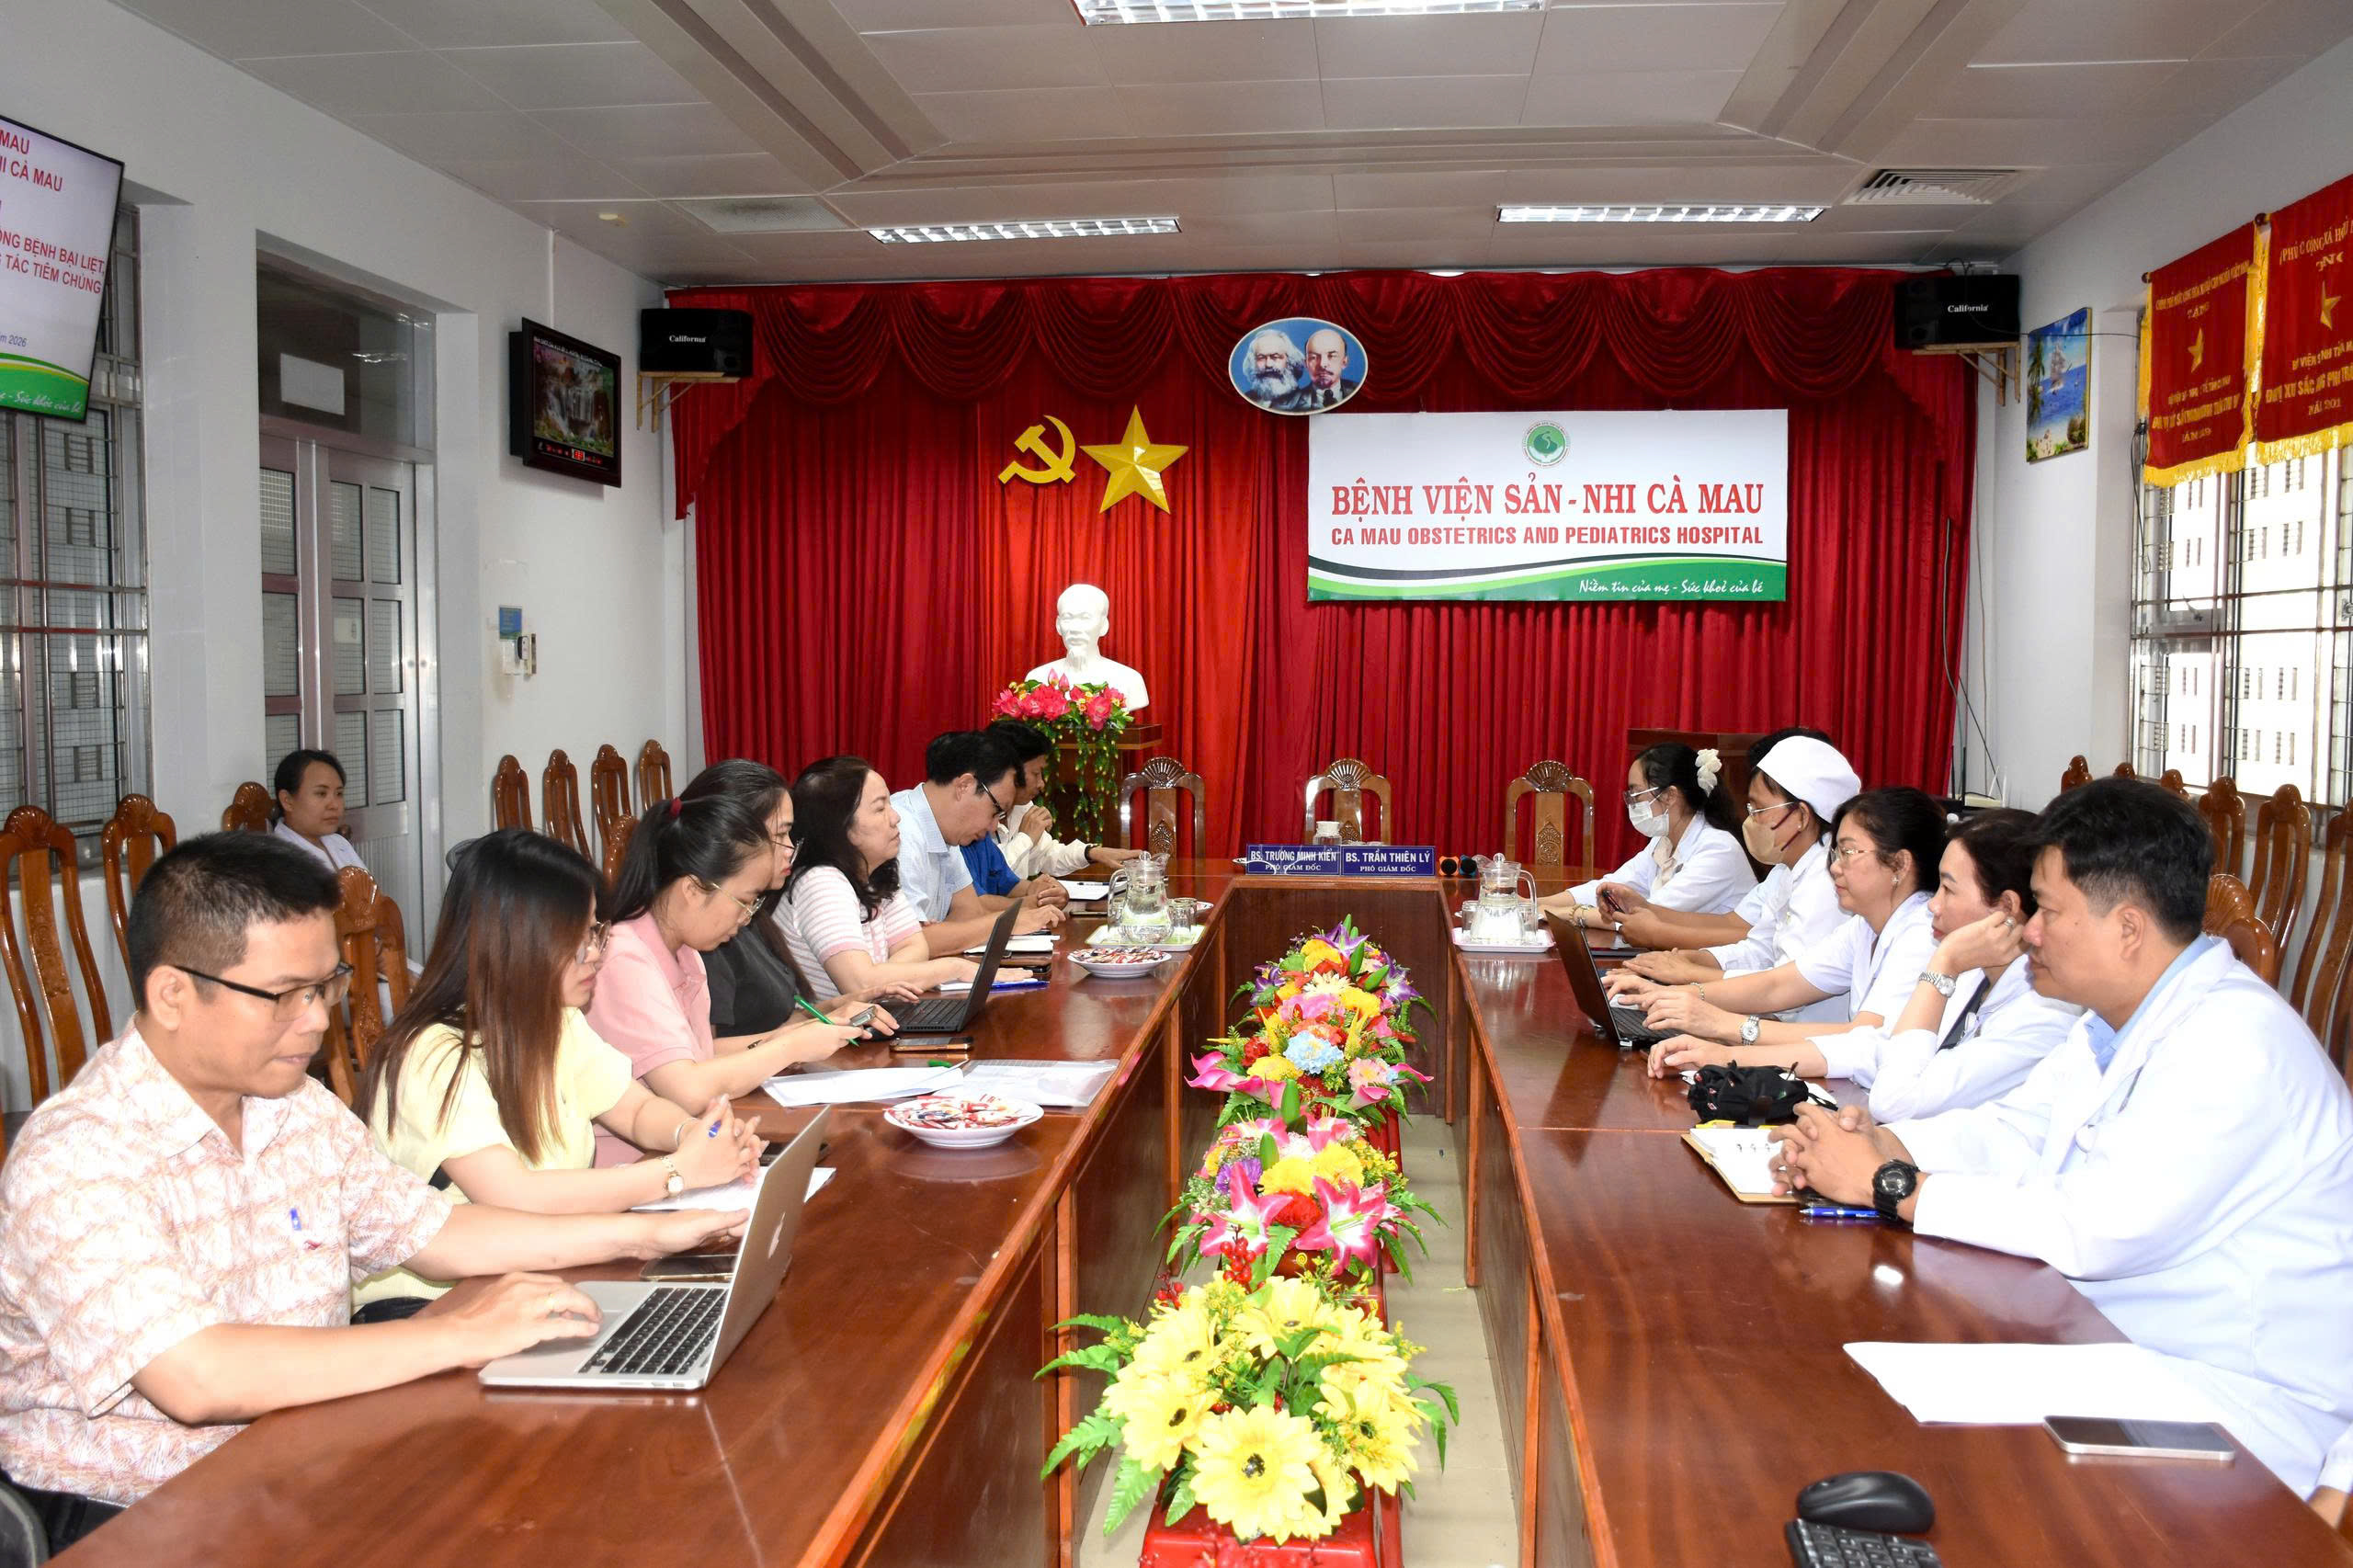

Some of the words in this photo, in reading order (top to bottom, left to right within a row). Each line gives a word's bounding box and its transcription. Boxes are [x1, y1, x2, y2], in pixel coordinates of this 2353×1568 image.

[10, 160, 29, 181] CÀ
[33, 168, 63, 191] MAU
[24, 237, 56, 259] BỆNH
[59, 248, 78, 268] BẠI
[33, 262, 60, 282] TIÊM
[8, 335, 28, 347] 2026
[1332, 477, 1413, 523] BỆNH
[1422, 475, 1494, 523] VIỆN
[1505, 472, 1563, 515] SẢN
[1583, 484, 1636, 514] NHI
[1647, 474, 1688, 514] CÀ
[1699, 484, 1764, 514] MAU
[1332, 528, 1354, 545] CA
[1361, 528, 1401, 545] MAU
[1408, 527, 1517, 545] OBSTETRICS
[1523, 527, 1559, 544] AND
[1565, 527, 1670, 544] PEDIATRICS
[1677, 527, 1763, 544] HOSPITAL
[1579, 579, 1608, 593] Niềm
[1611, 581, 1630, 593] tin
[1632, 580, 1652, 593] của
[1654, 585, 1669, 596] mẹ
[1681, 578, 1700, 593] Sức
[1730, 580, 1749, 593] của
[1752, 580, 1763, 593] bé
[1251, 850, 1263, 860] BS.
[1265, 849, 1295, 861] TRƯƠNG
[1346, 852, 1360, 862] BS.
[1389, 850, 1416, 862] THIÊN
[1419, 850, 1430, 863] LÝ
